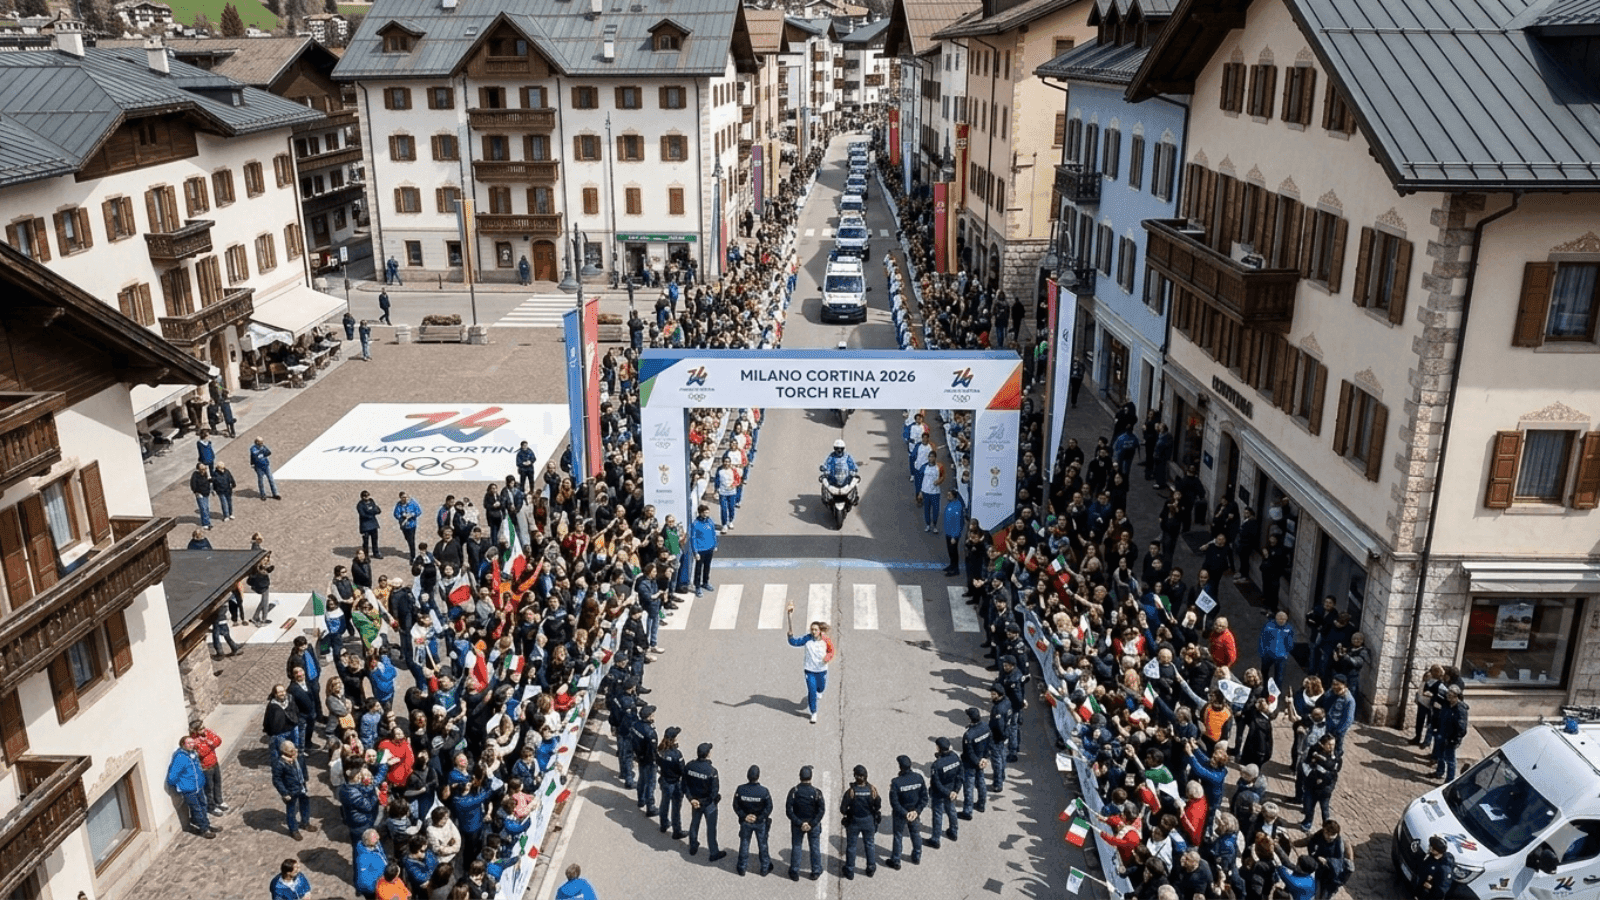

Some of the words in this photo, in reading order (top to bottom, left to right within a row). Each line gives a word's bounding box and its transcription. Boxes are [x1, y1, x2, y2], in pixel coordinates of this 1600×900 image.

[740, 370, 801, 382] MILANO
[806, 370, 876, 382] CORTINA
[879, 370, 916, 382] 2026
[775, 387, 828, 398] TORCH
[832, 387, 880, 399] RELAY
[322, 445, 425, 453] MILANO
